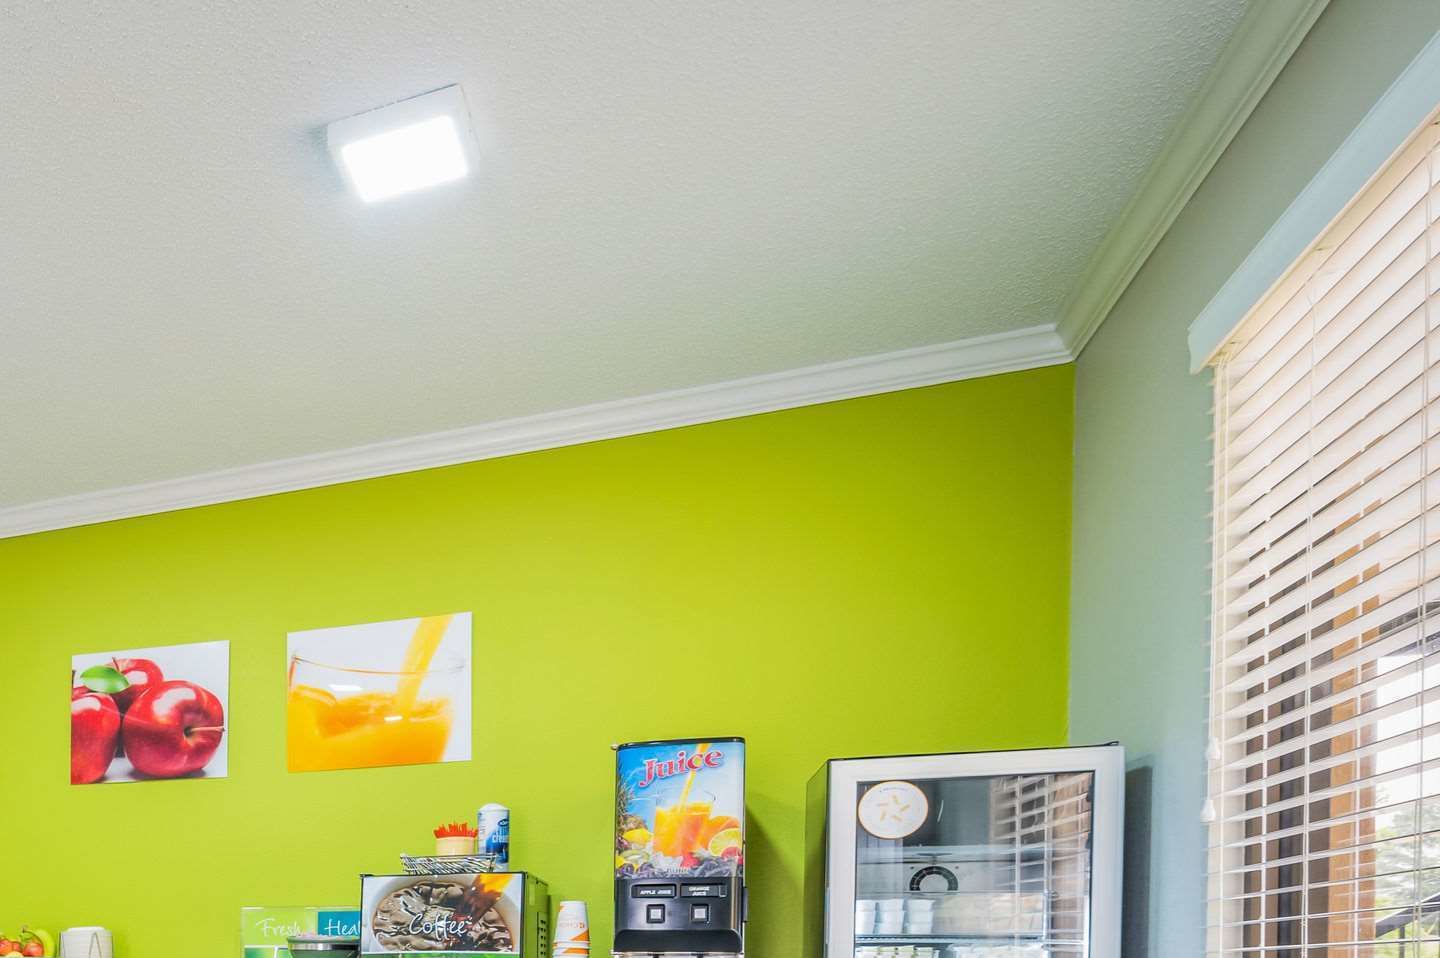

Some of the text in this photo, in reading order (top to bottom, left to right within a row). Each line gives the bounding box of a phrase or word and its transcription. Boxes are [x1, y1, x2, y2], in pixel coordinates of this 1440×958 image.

[639, 751, 724, 787] Juice
[255, 918, 303, 938] Fresh
[408, 912, 468, 941] Coffee
